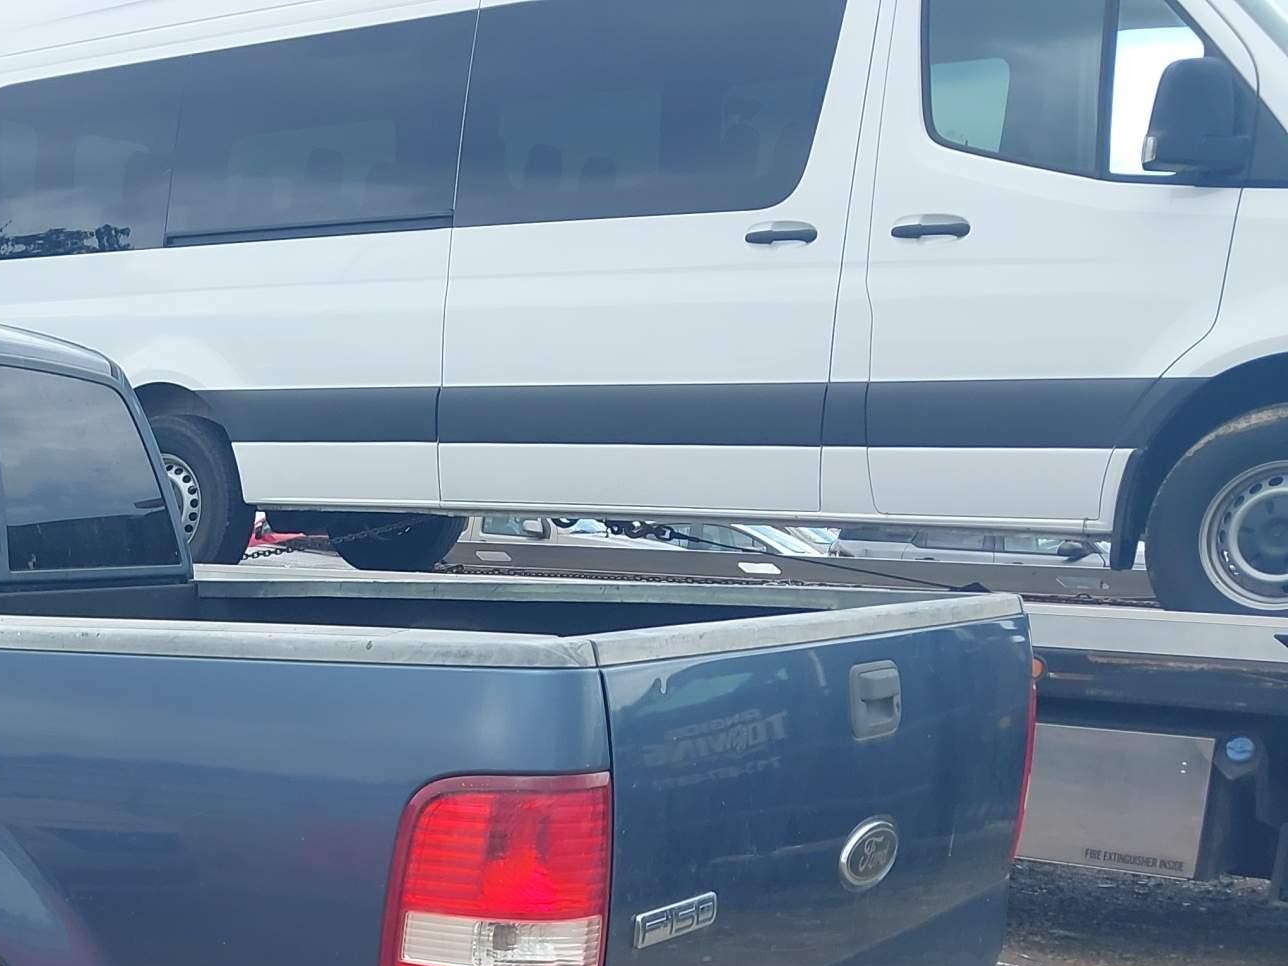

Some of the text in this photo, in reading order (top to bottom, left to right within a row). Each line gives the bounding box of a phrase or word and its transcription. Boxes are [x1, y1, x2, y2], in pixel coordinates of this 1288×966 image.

[1084, 847, 1185, 872] FIRE EXTINGUISHER INSIDE
